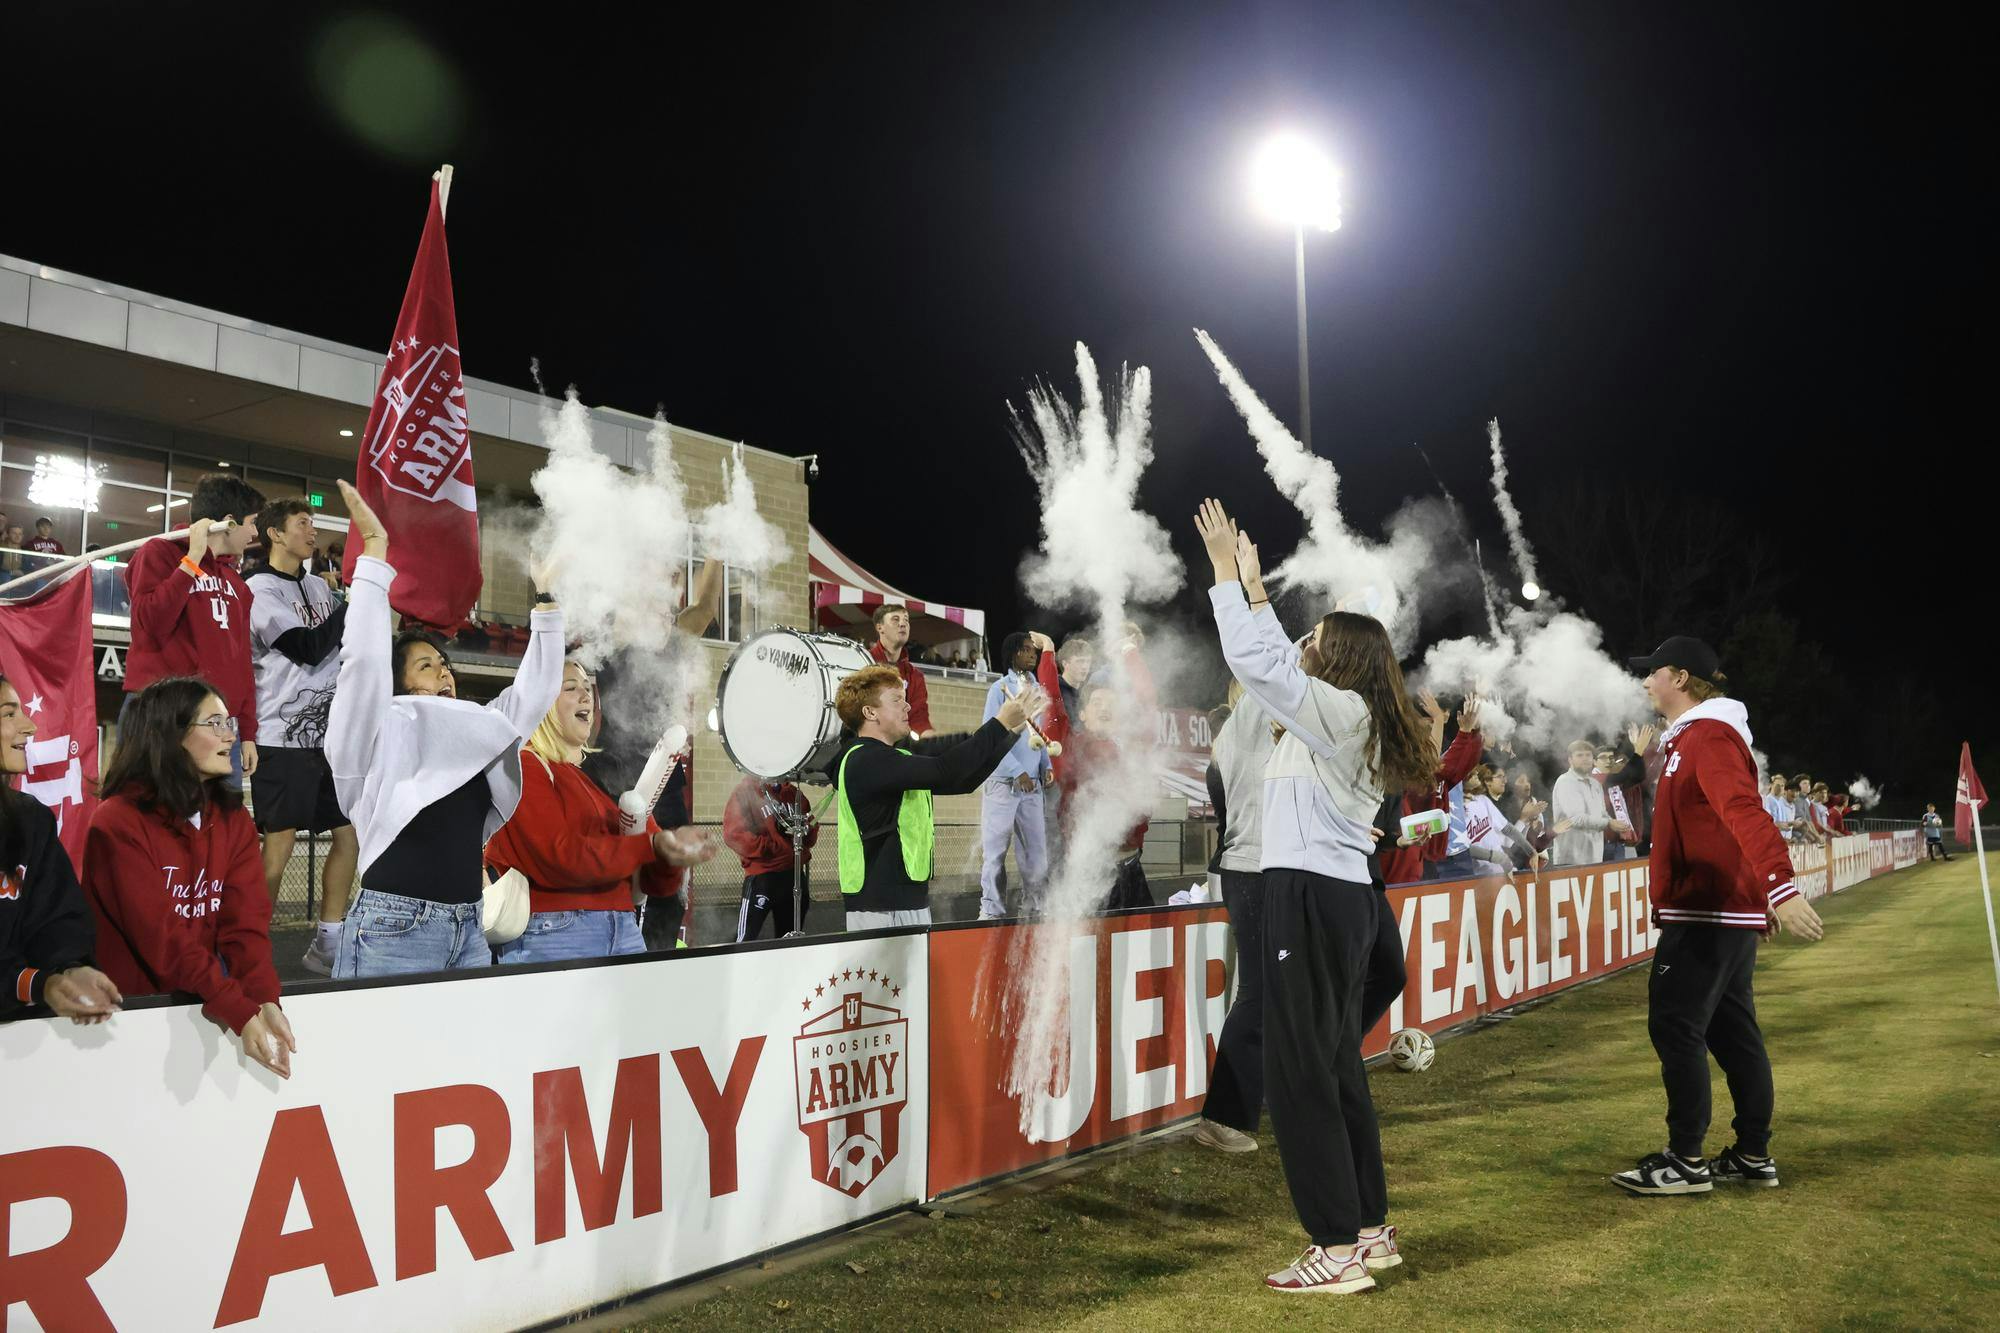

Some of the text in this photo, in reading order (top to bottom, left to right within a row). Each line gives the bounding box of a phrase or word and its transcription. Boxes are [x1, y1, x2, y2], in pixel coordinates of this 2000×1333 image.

[389, 370, 451, 464] HOOSIER
[769, 648, 810, 677] YAMAHA
[1390, 874, 1595, 1035] YEAGLEY
[1602, 864, 1662, 967] FIEL
[806, 1052, 900, 1114] ARMY
[812, 1033, 892, 1059] HOOSIER
[213, 1035, 768, 1329] ARMY
